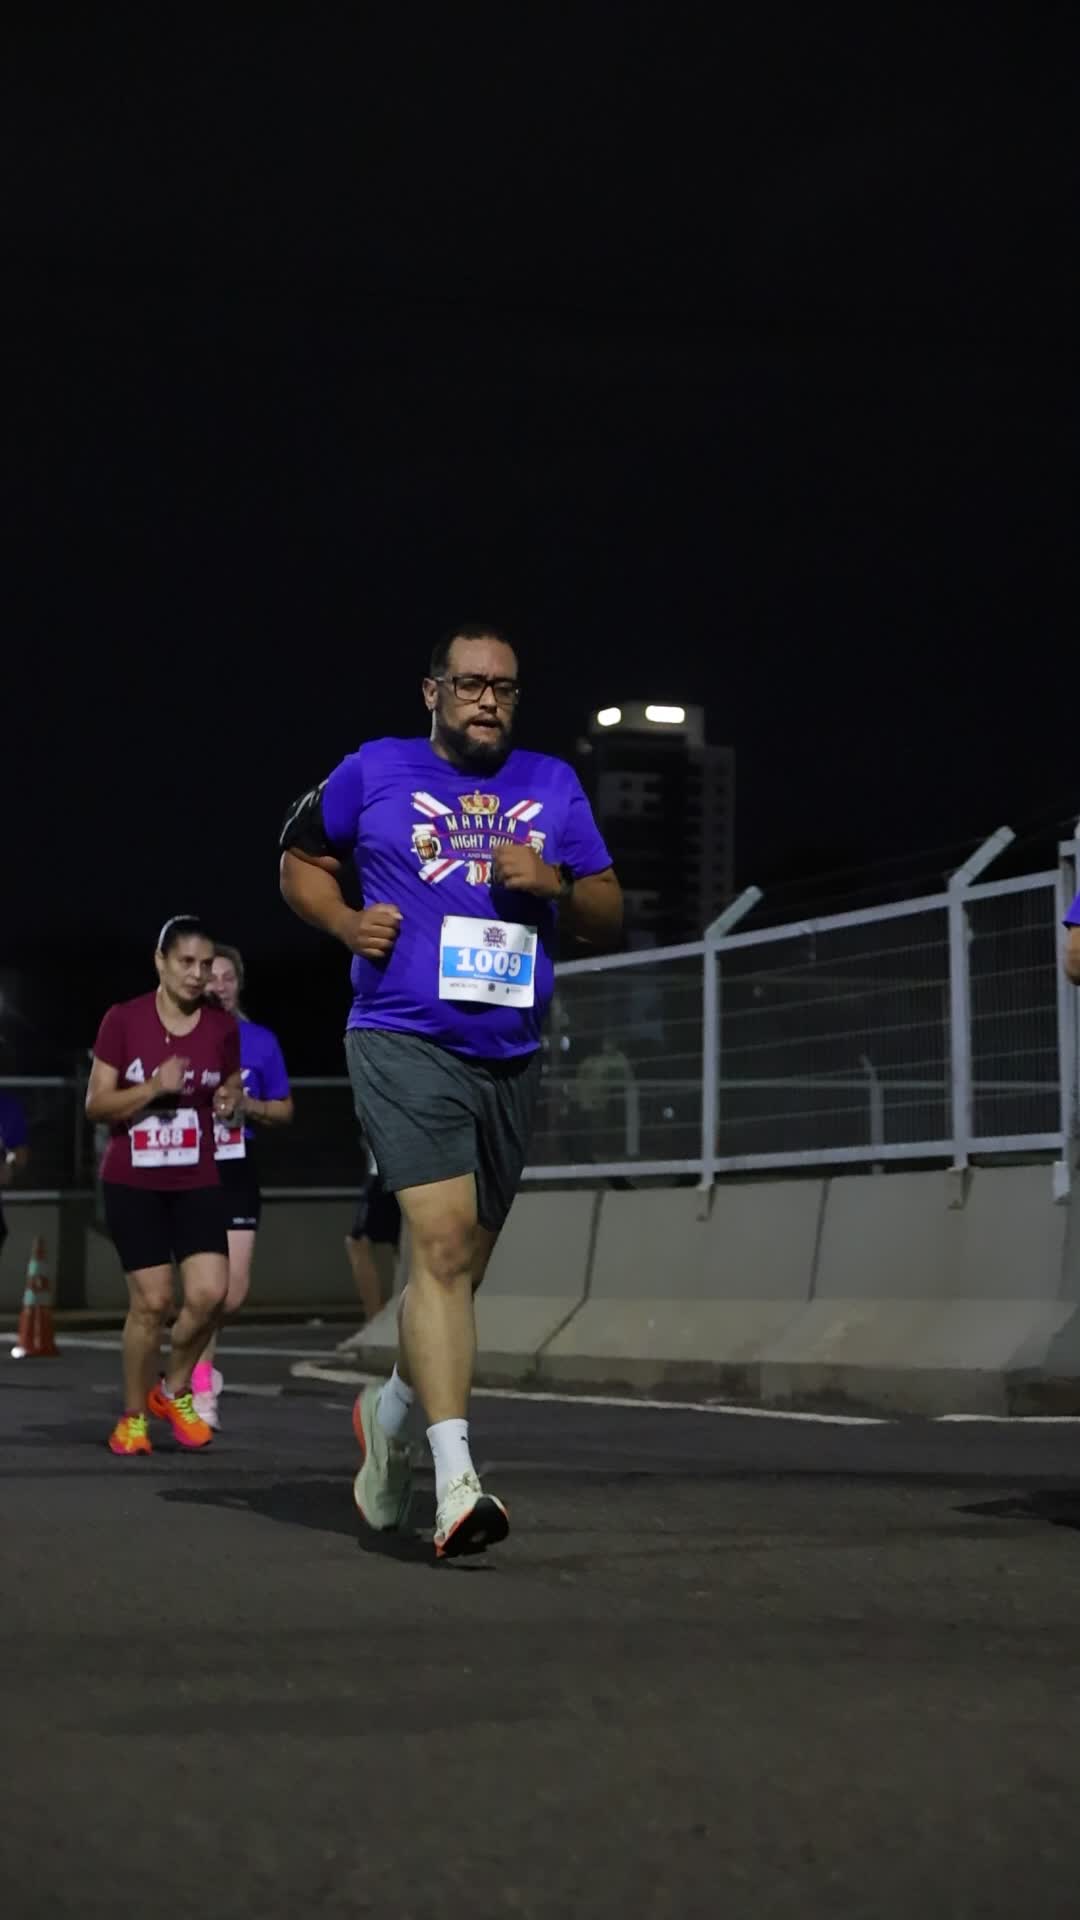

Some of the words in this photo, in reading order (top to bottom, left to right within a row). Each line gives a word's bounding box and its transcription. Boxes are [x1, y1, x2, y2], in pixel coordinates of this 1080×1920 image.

[445, 815, 517, 833] MARVIN
[450, 834, 484, 850] NIGHT
[456, 948, 521, 977] 1009
[147, 1127, 183, 1146] 168
